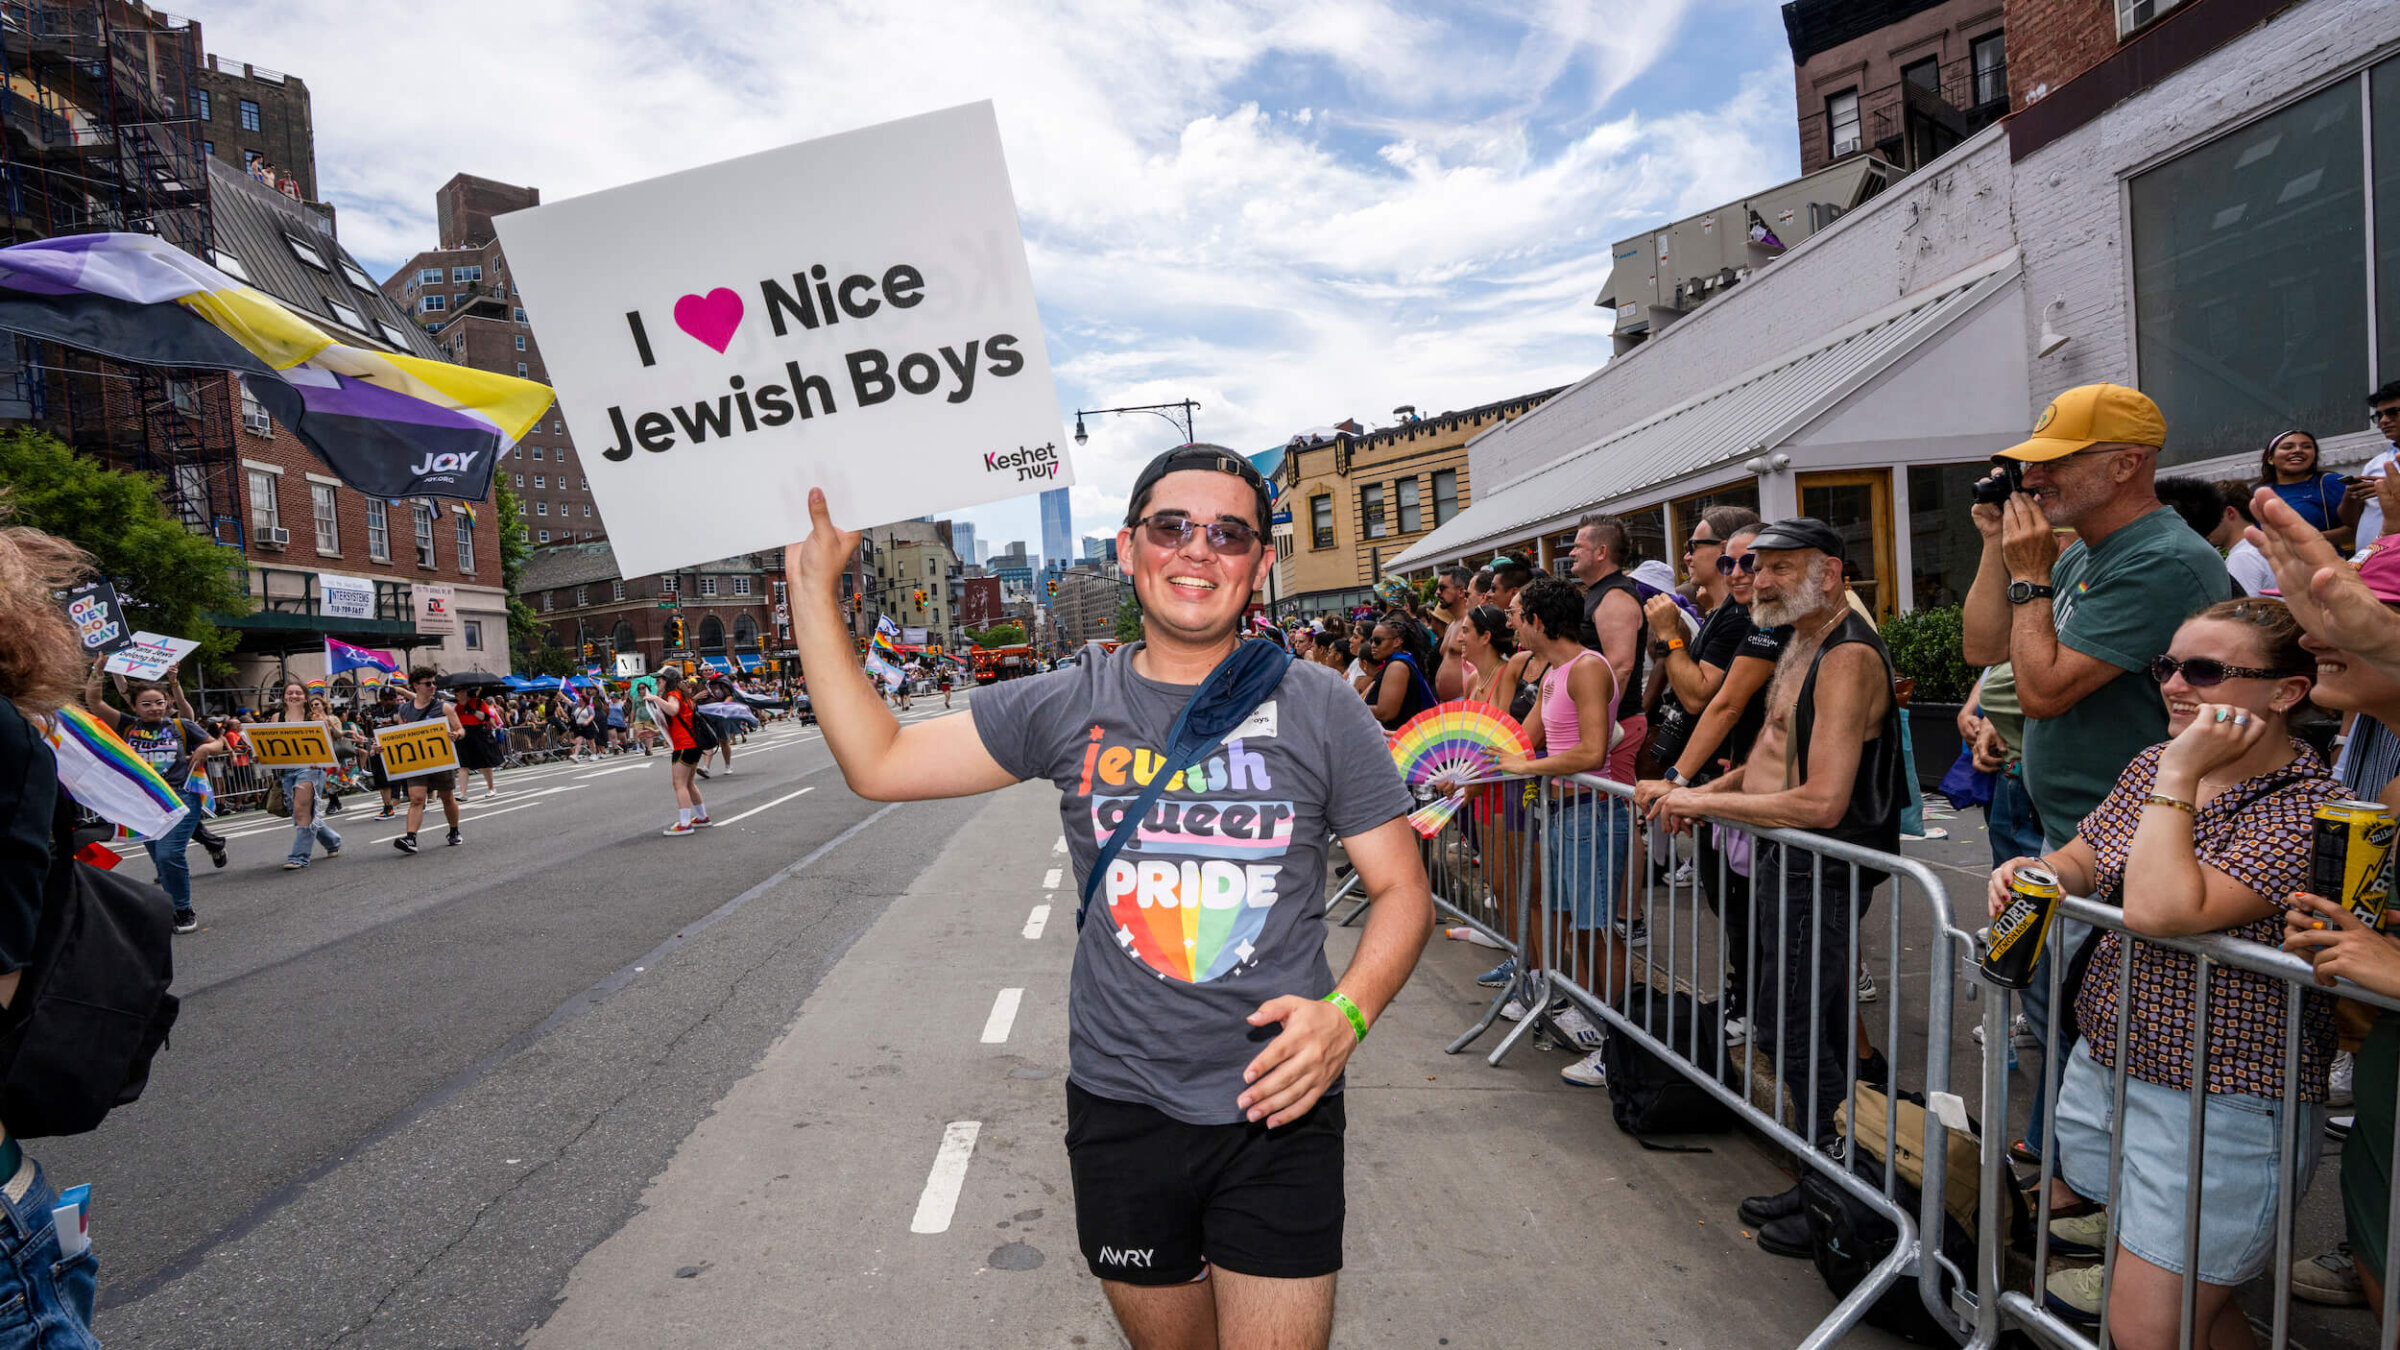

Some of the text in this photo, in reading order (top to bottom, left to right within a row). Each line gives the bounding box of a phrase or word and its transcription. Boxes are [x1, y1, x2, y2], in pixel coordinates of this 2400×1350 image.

[626, 310, 656, 368] I
[759, 264, 925, 337] Nice
[602, 334, 1024, 462] Jewish Boys
[984, 442, 1058, 472] Keshet
[1017, 460, 1059, 482] קשת
[72, 599, 92, 614] OY
[328, 589, 370, 604] INTERSYSTEMS
[76, 605, 105, 624] VEY
[81, 620, 103, 635] SO
[87, 625, 116, 645] GAY
[119, 651, 168, 664] belong here
[257, 738, 326, 757] הומו
[382, 733, 406, 742] NOBODY
[387, 737, 448, 765] הומו
[1106, 859, 1284, 910] PRIDE
[1995, 919, 2032, 956] LEMONADE
[1099, 1245, 1154, 1268] AWRY
